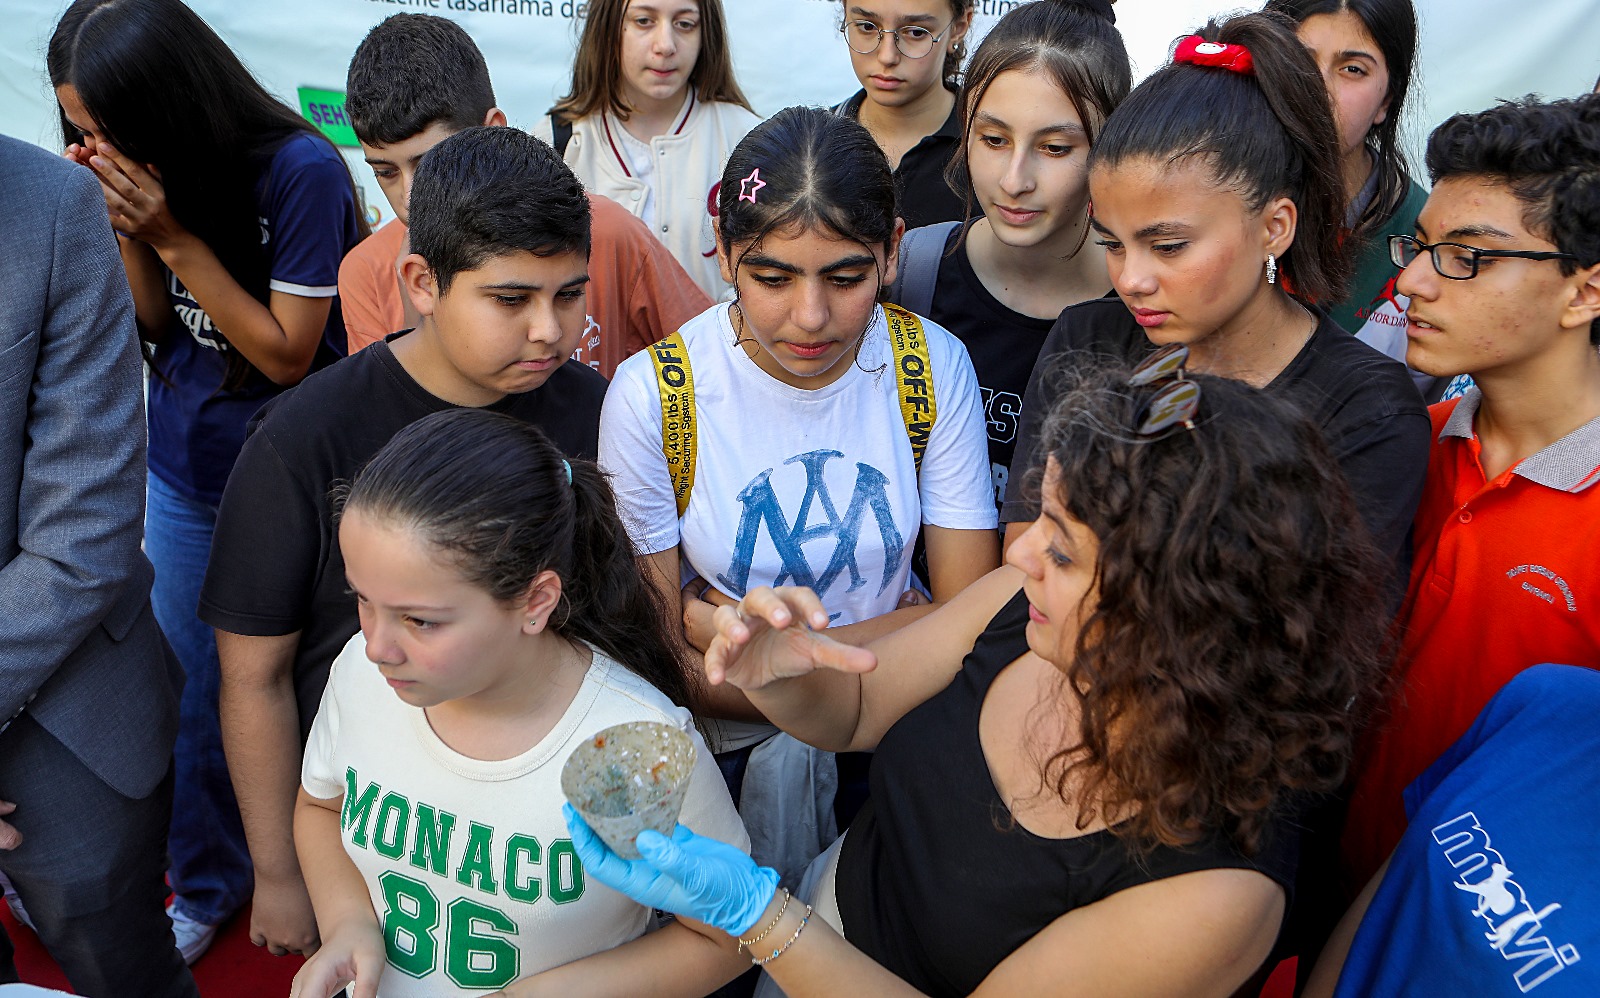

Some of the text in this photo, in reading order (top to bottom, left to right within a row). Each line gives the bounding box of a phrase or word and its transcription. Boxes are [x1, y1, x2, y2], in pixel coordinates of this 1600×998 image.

[681, 432, 692, 474] Securing
[340, 766, 586, 905] MONACO
[378, 869, 521, 990] 86
